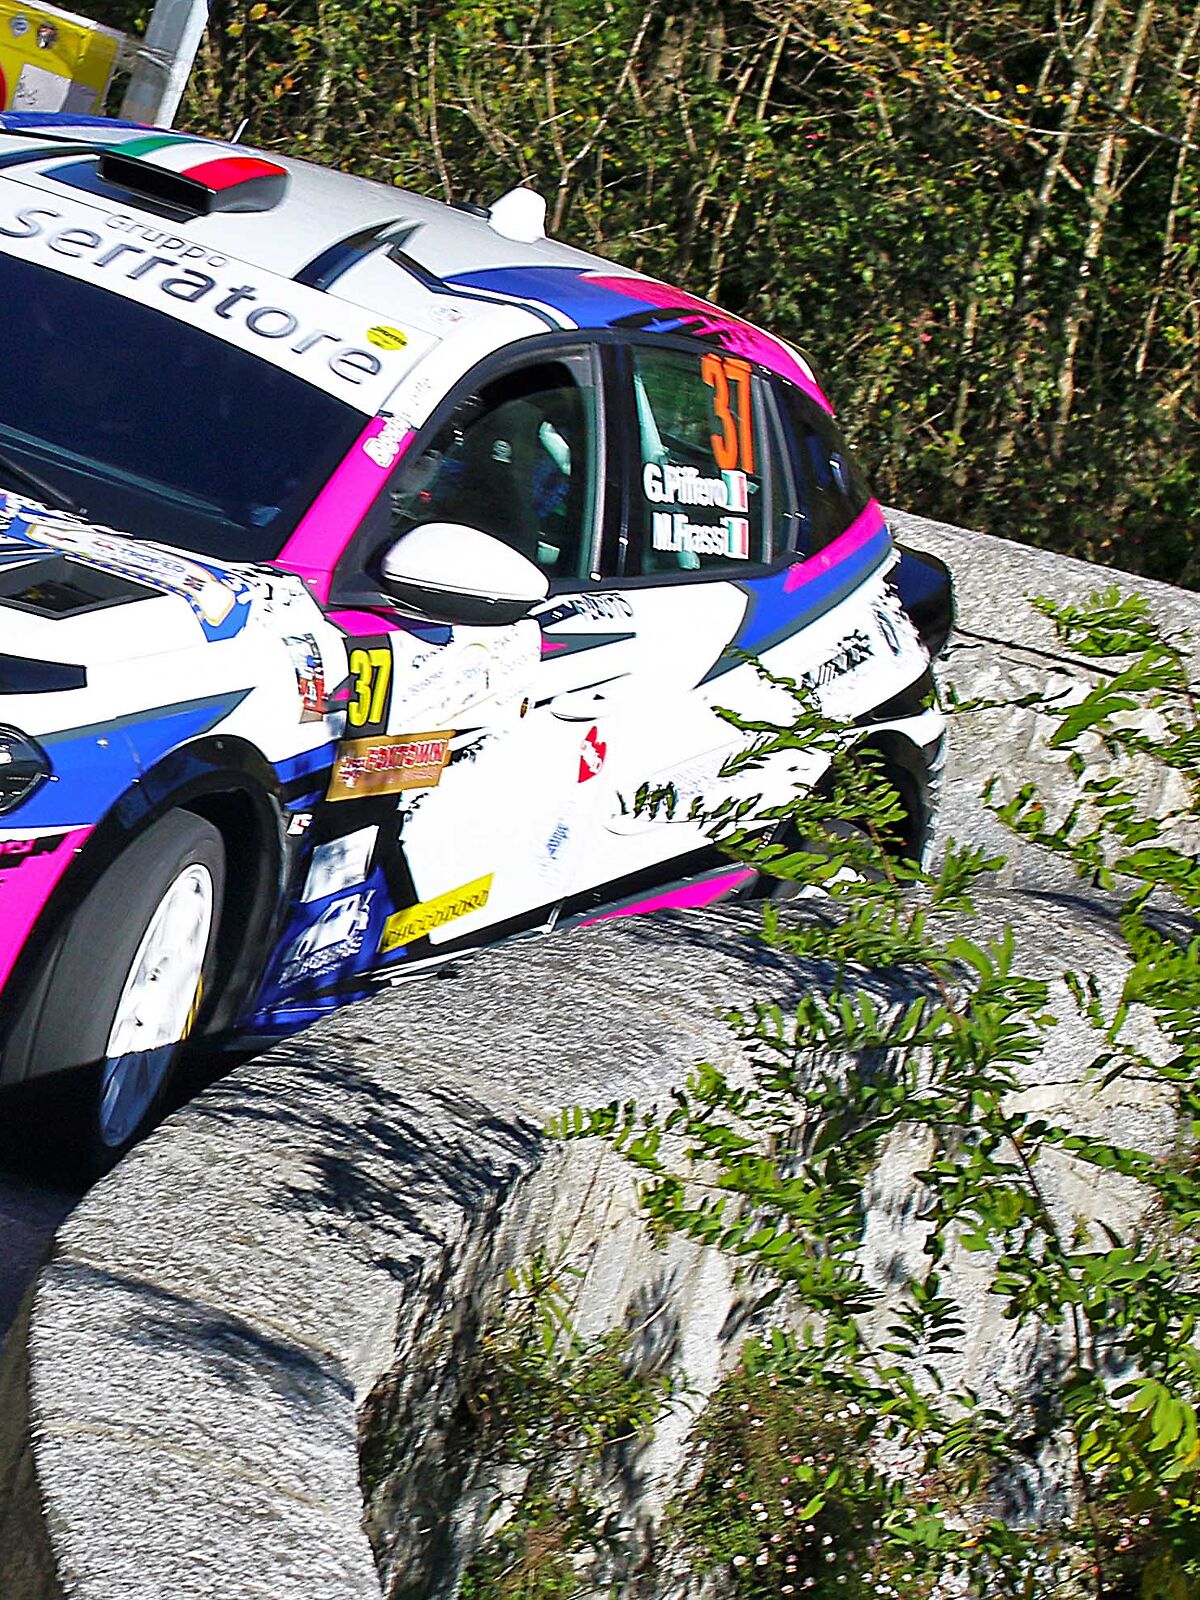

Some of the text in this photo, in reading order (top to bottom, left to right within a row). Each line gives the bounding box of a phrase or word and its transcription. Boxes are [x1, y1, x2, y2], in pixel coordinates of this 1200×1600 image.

[105, 213, 230, 268] Gruppo
[702, 353, 754, 475] 37
[349, 648, 392, 727] 37
